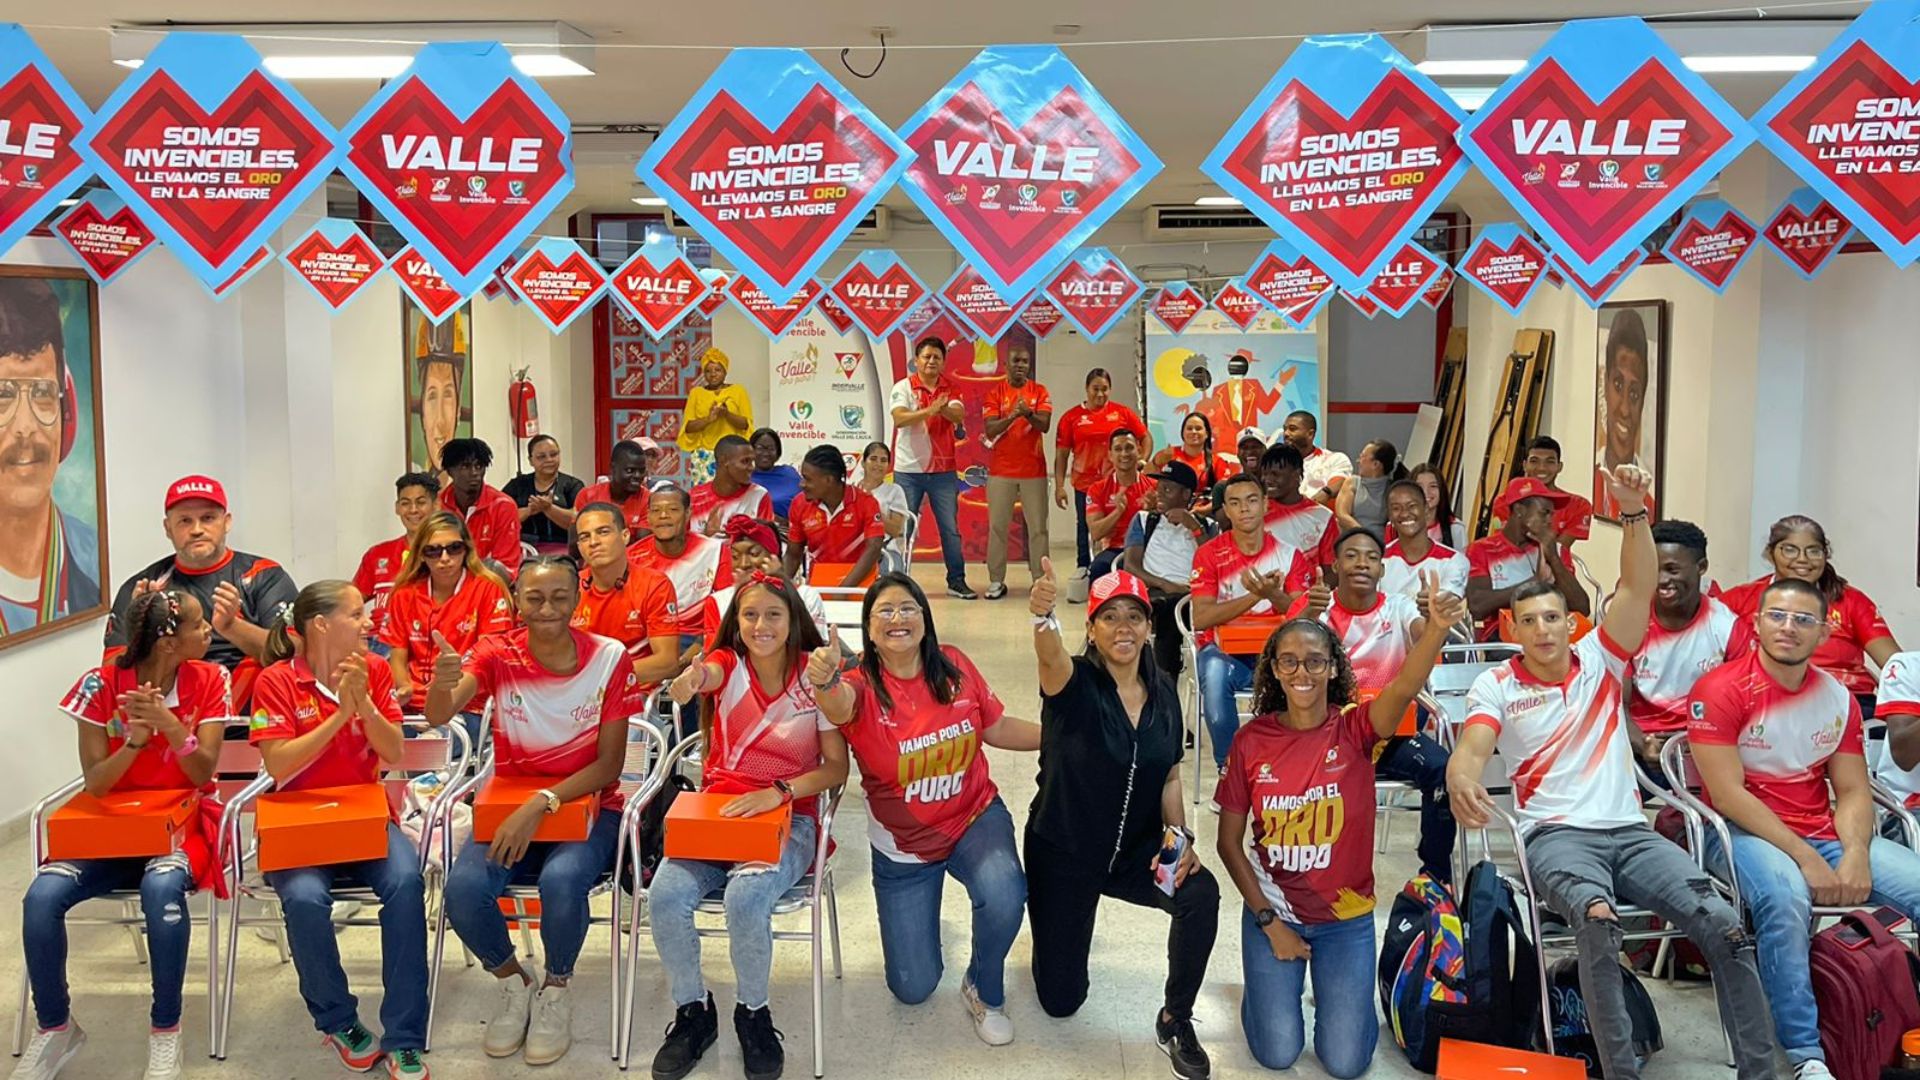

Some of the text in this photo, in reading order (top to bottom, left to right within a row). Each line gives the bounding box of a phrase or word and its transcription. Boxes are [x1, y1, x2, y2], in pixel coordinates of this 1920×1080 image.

[1855, 97, 1920, 118] SOM
[163, 127, 260, 146] SOMOS
[1300, 127, 1400, 156] SOMOS
[1512, 119, 1687, 155] VALLE
[1807, 121, 1920, 144] INVENC
[124, 149, 299, 169] INVENCIBLES,
[381, 134, 542, 172] VALLE
[728, 142, 824, 166] SOMOS
[934, 140, 1099, 182] VALLE
[1818, 144, 1919, 159] LLEVAMOS
[1260, 146, 1442, 184] INVENCIBLES,
[1835, 162, 1862, 174] EN
[1867, 161, 1893, 173] LA
[135, 172, 281, 184] LLEVAMOS EL ORO
[690, 163, 865, 191] INVENCIBLES,
[1272, 171, 1424, 198] LLEVAMOS EL ORO
[1589, 181, 1628, 189] Invencible
[151, 187, 270, 199] EN LA SANGRE
[702, 187, 847, 206] LLEVAMOS EL ORO
[1290, 188, 1414, 212] EN LA SANGRE
[717, 202, 836, 221] EN LA SANGRE
[87, 223, 127, 235] SOMOS
[1695, 231, 1732, 246] SOMOS
[1777, 219, 1839, 239] VALLE
[317, 252, 356, 262] SOMOS
[1489, 254, 1524, 264] SOMOS
[538, 271, 577, 280] SOMOS
[1274, 269, 1312, 280] SOMOS
[1379, 262, 1422, 277] LLE
[626, 275, 692, 294] VALLE
[846, 283, 910, 298] VALLE
[1061, 281, 1124, 296] VALLE
[786, 328, 826, 336] encible
[776, 360, 816, 378] Valle
[780, 430, 826, 439] nvencible
[789, 421, 814, 429] Valle
[177, 482, 213, 494] VALLE
[1506, 697, 1542, 714] Valle
[899, 718, 974, 754] VAMOS POR EL
[898, 731, 976, 788] ORO
[905, 770, 966, 803] PURO
[1262, 794, 1304, 811] VAMOS
[1326, 782, 1341, 798] EL
[1260, 796, 1345, 848] ORO
[1268, 843, 1332, 872] PURO
